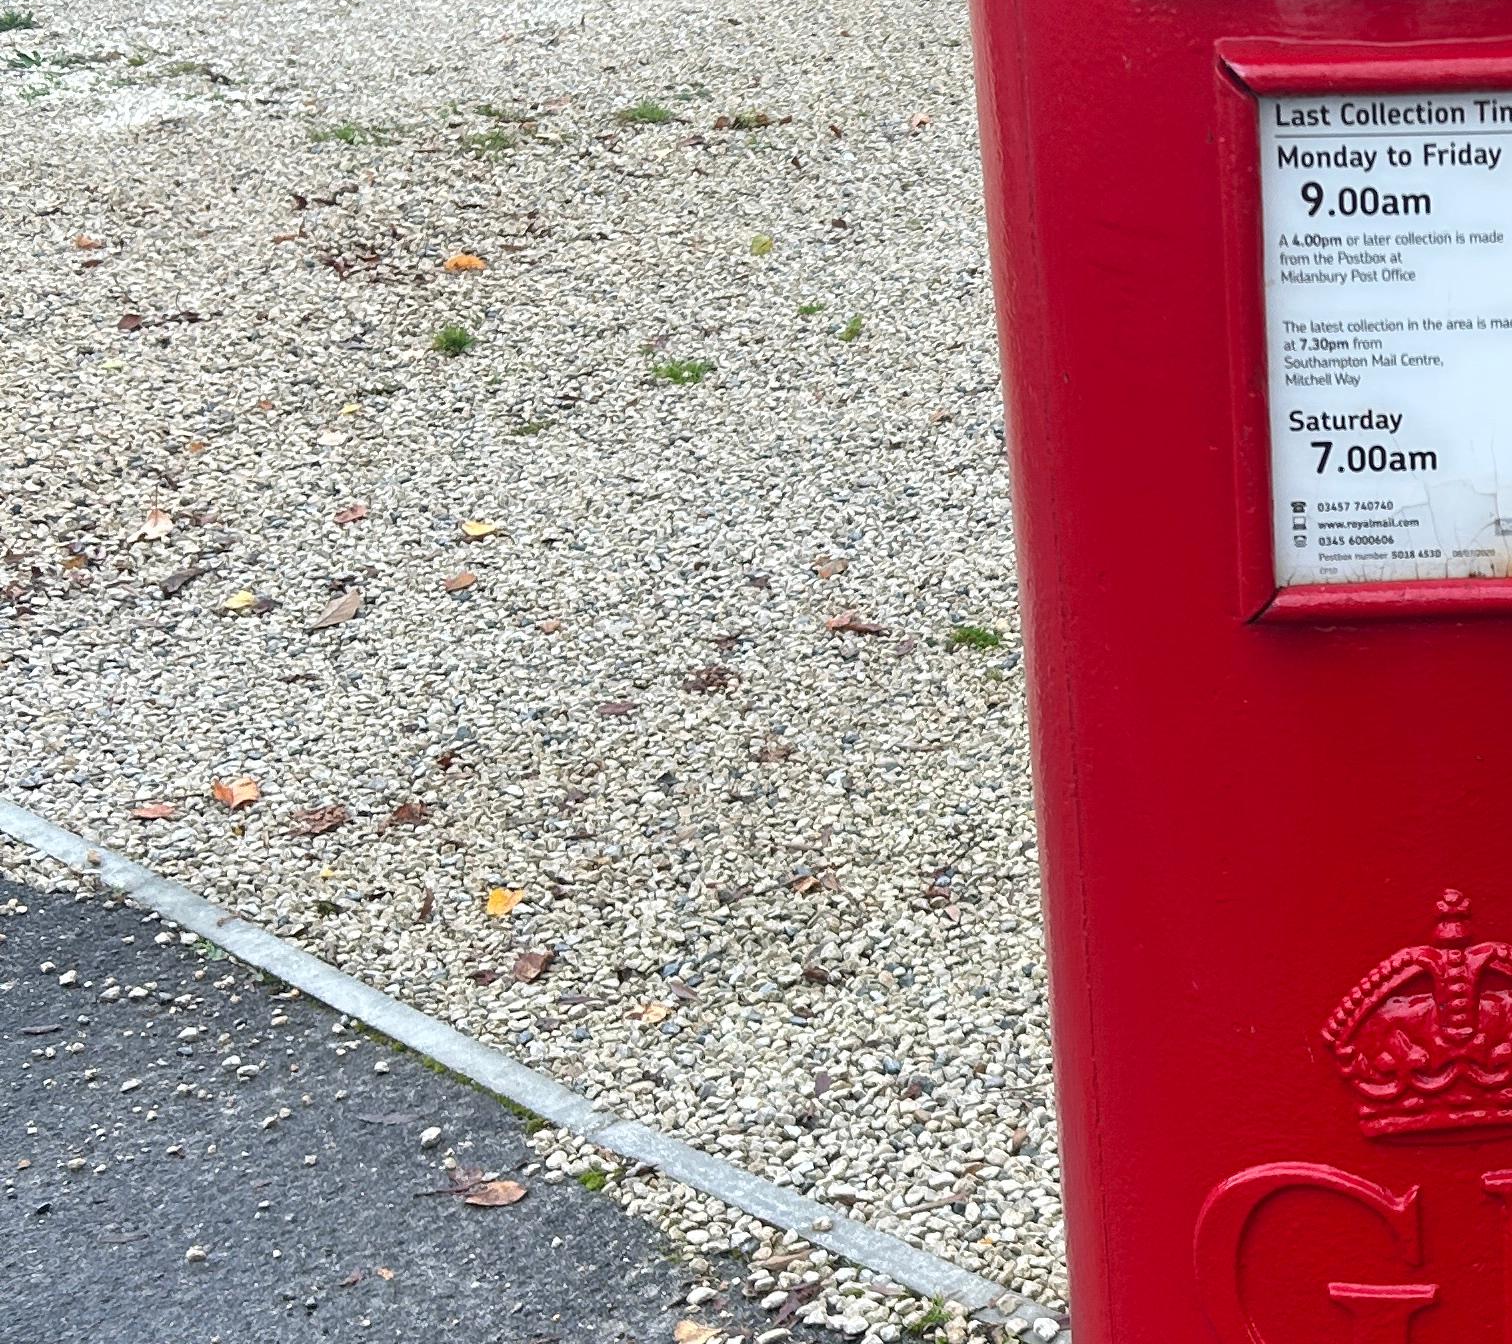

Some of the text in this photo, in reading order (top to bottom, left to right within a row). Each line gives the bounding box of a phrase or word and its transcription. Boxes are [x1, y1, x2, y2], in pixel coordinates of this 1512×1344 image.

[1275, 104, 1330, 126] Last
[1341, 102, 1465, 125] Collection
[1277, 143, 1502, 172] Monday to Friday
[1301, 181, 1431, 217] 9.00am
[1279, 230, 1504, 249] A 4.00pm or later collection is made
[1280, 250, 1402, 266] from the Postbox at
[1351, 269, 1379, 282] Post
[1382, 268, 1417, 282] Office
[1283, 320, 1307, 334] The
[1310, 319, 1345, 333] latest
[1347, 317, 1403, 332] collection
[1407, 317, 1419, 331] in
[1423, 317, 1443, 331] the
[1446, 319, 1473, 330] area
[1477, 317, 1487, 329] is
[1284, 337, 1383, 354] at 7.30pm from
[1284, 352, 1444, 371] Southampton Mail Centre,
[1285, 372, 1361, 388] Mitchell Way
[1289, 410, 1403, 433] Saturday
[1310, 442, 1438, 474] 7.00am
[1317, 501, 1394, 513] 03457 740740
